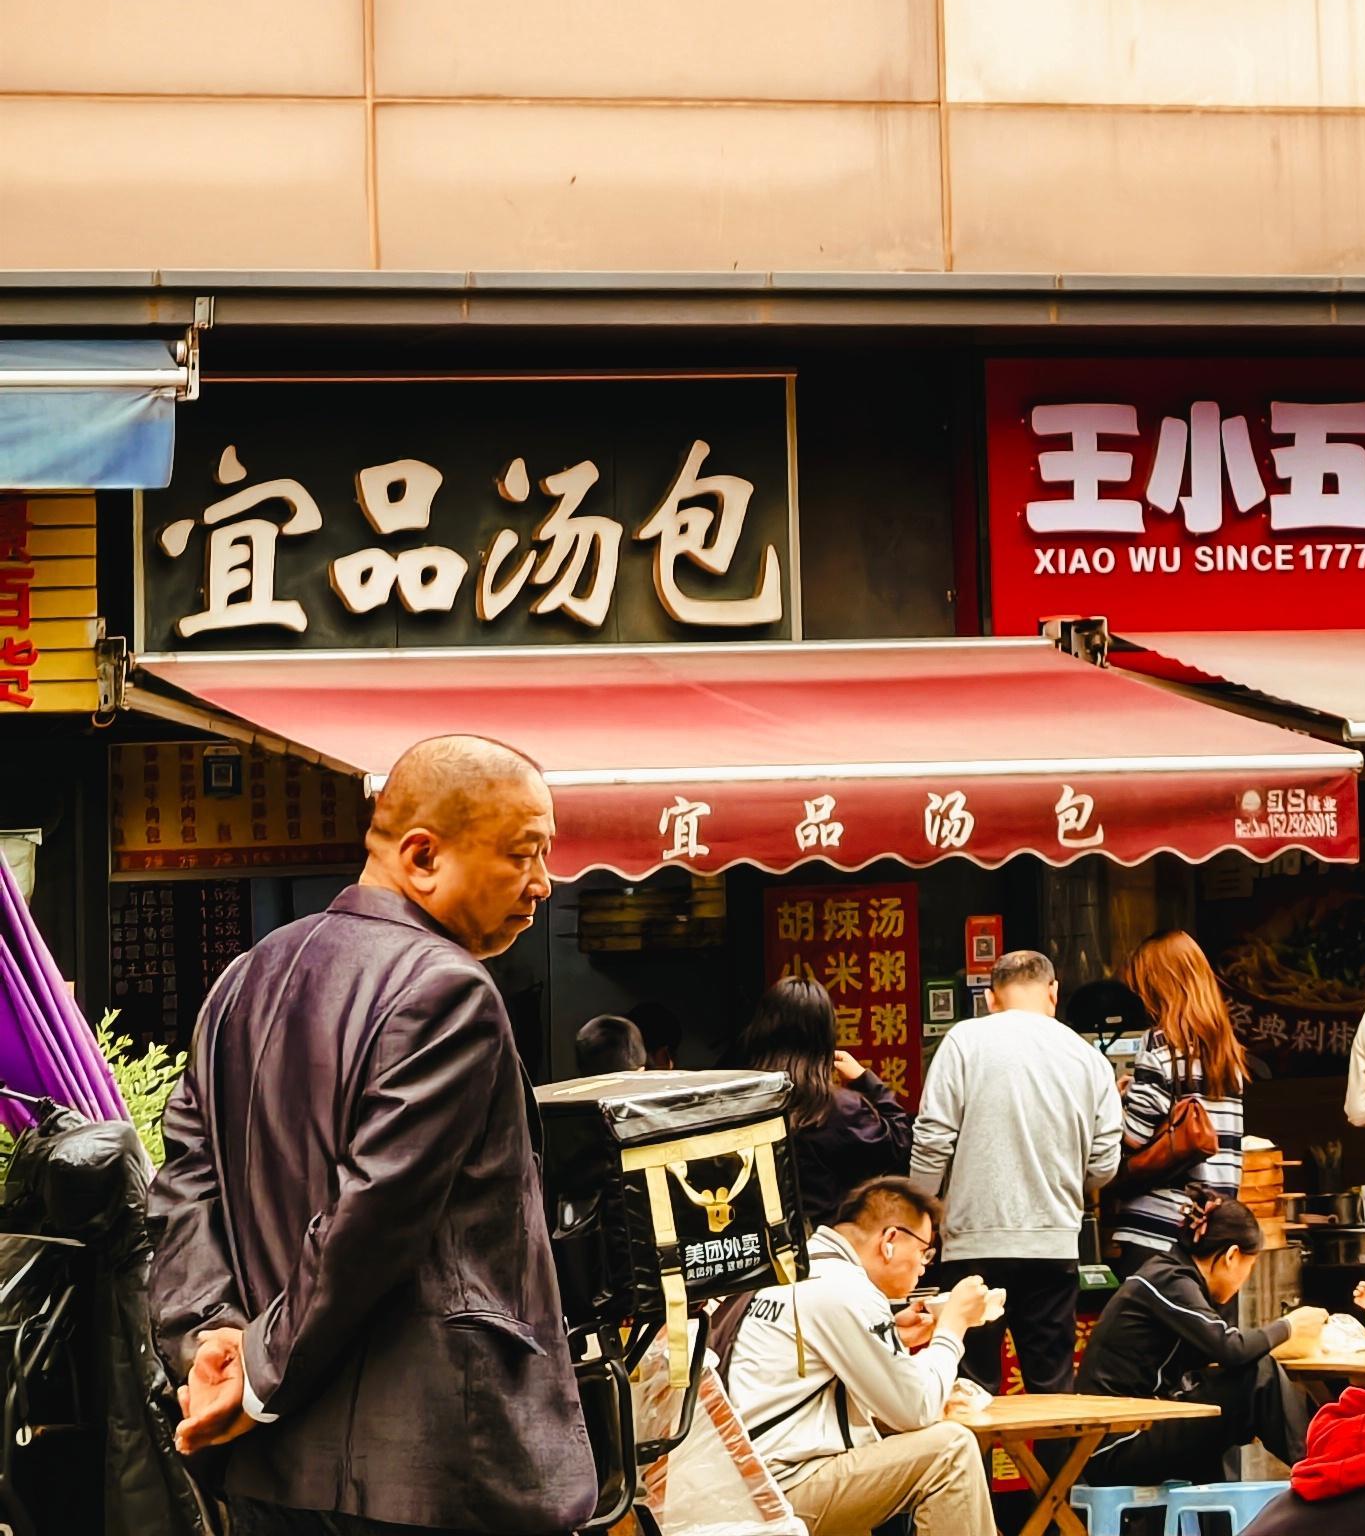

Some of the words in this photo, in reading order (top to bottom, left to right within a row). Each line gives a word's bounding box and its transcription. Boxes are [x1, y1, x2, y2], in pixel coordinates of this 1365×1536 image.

[157, 439, 783, 638] 宜品汤包
[1033, 547, 1116, 575] XIAO
[1128, 546, 1182, 574] WU
[777, 897, 905, 942] 胡辣汤
[834, 1003, 909, 1047] 宝粥
[684, 1233, 761, 1264] 美团外卖
